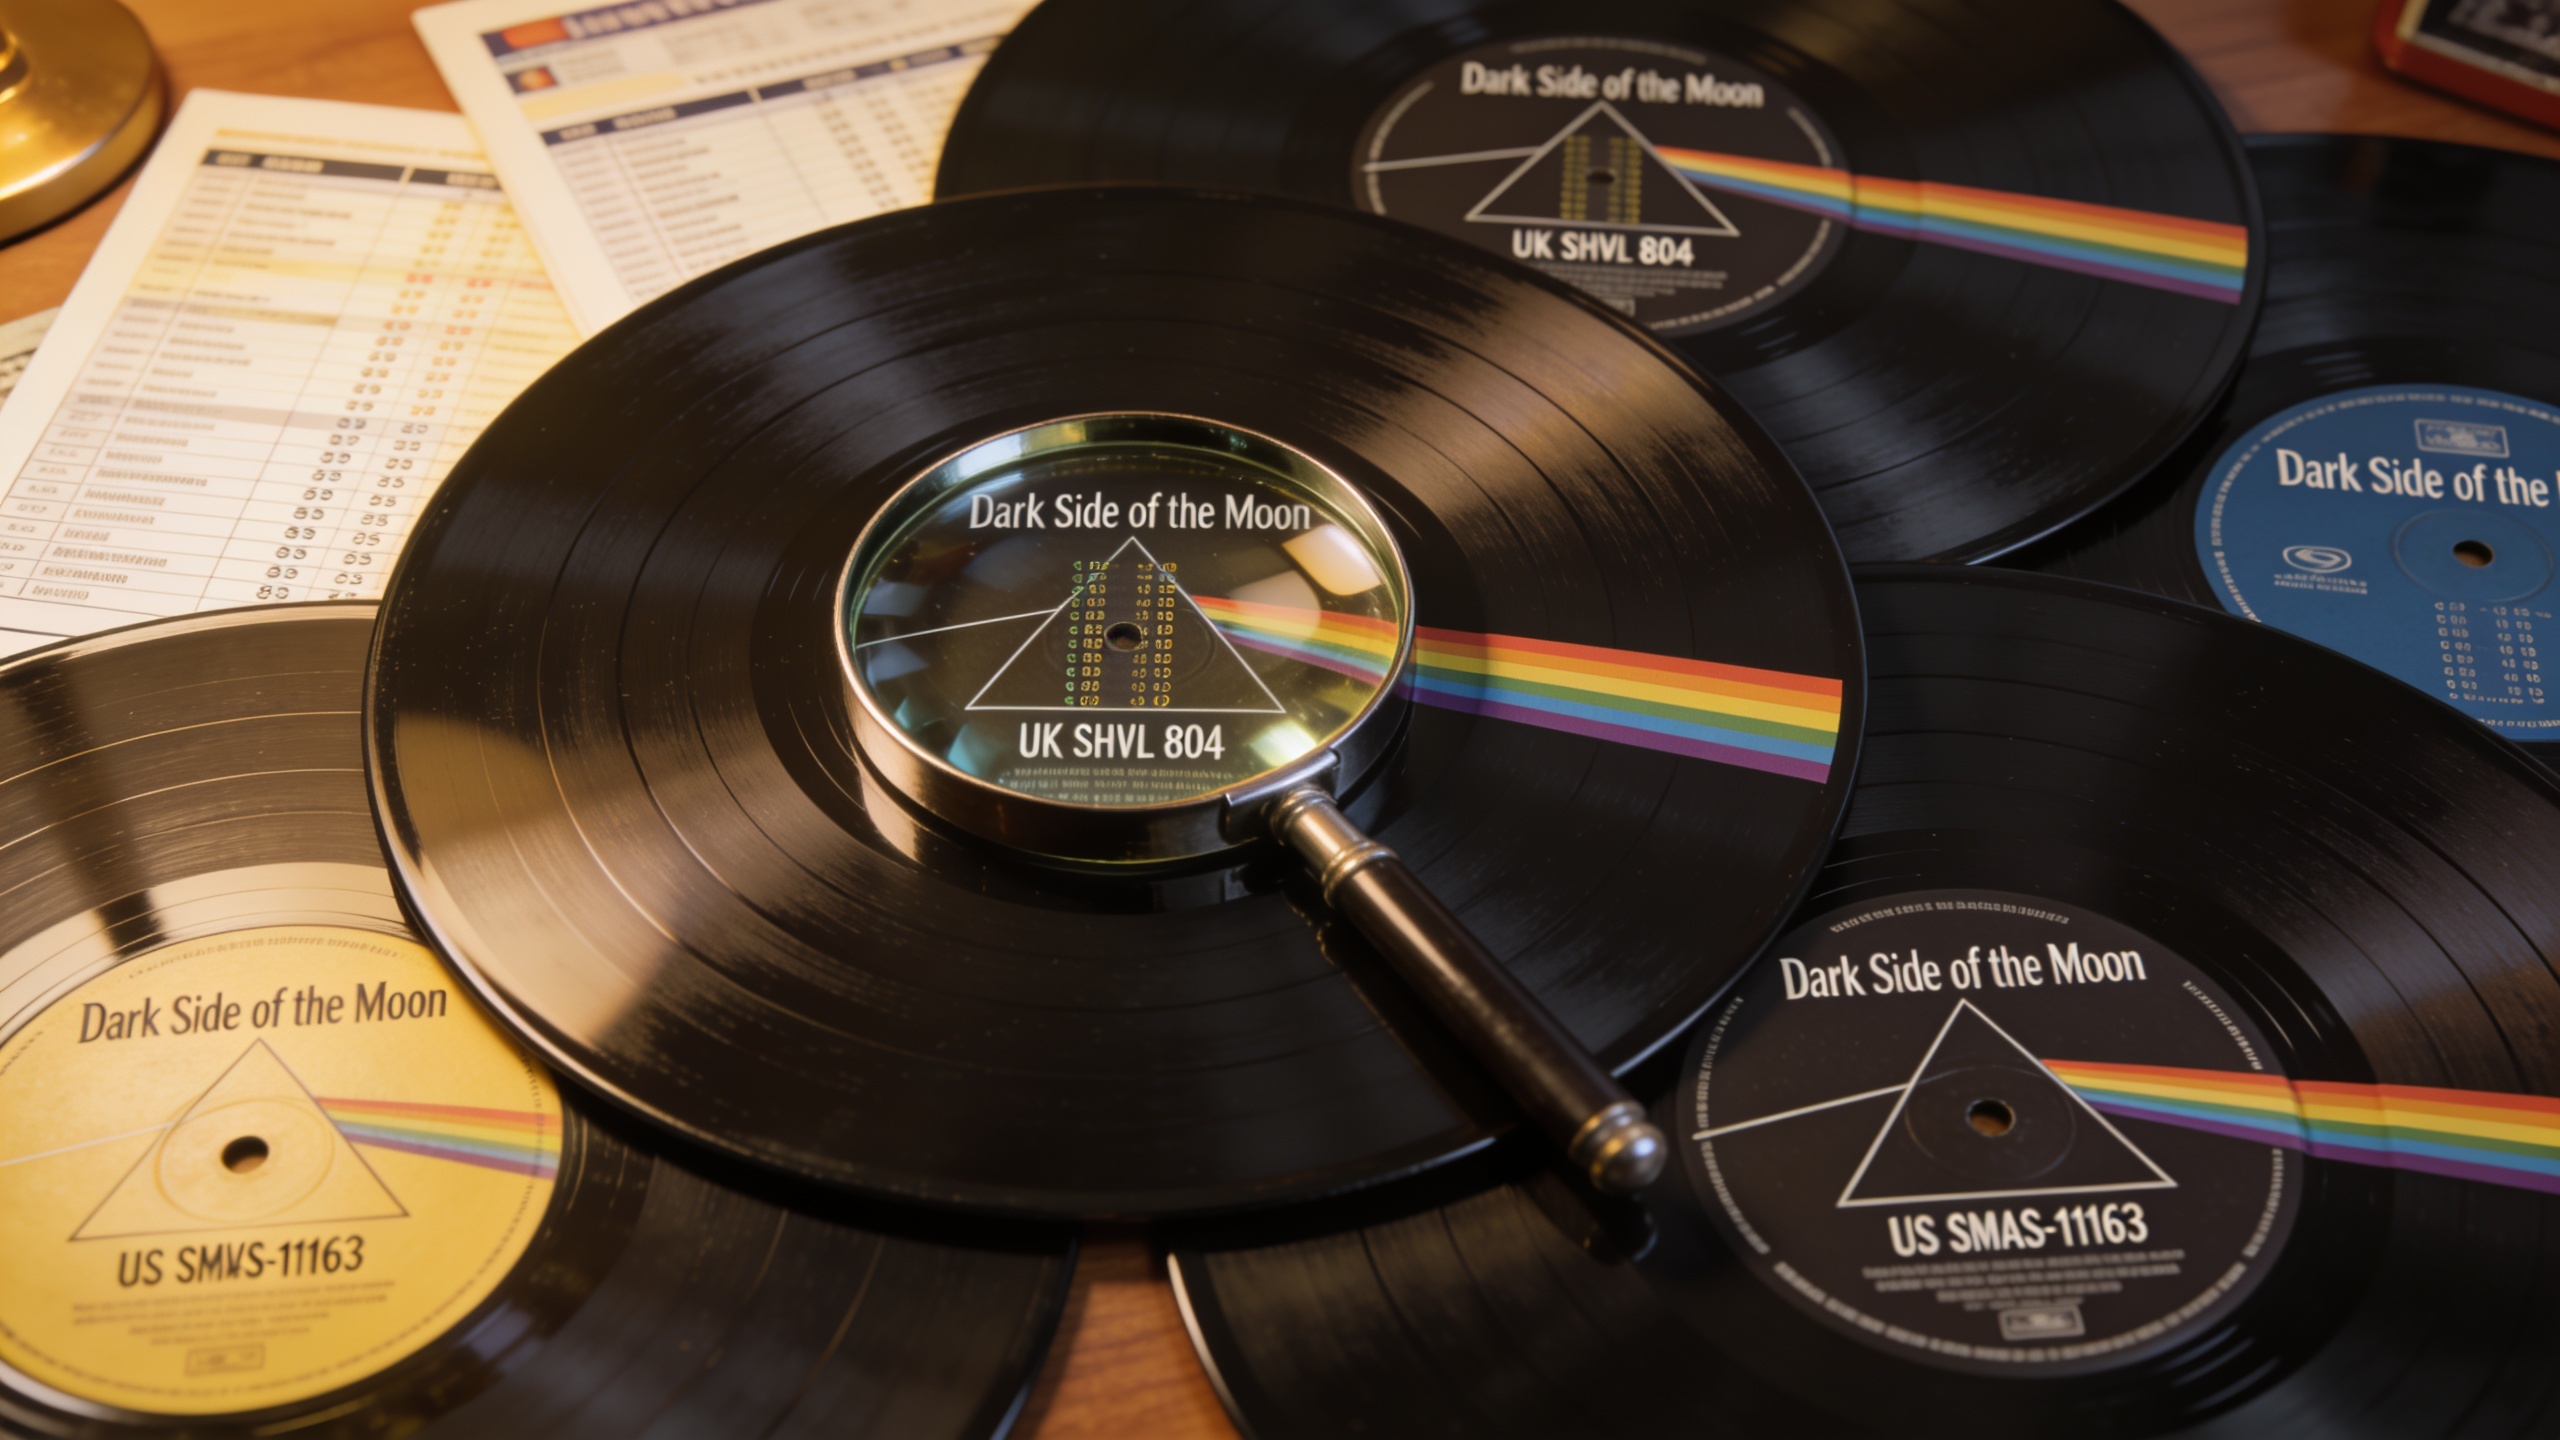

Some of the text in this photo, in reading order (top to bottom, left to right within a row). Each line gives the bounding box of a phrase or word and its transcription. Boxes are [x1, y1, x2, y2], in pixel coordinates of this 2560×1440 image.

[1461, 61, 1765, 108] Dark Side of the Moon
[1512, 228, 1695, 267] UK SHVL 804
[2276, 448, 2363, 492] Dark
[2367, 455, 2444, 499] Side
[2453, 463, 2488, 502] of
[2494, 466, 2550, 507] the
[969, 491, 1312, 530] Dark Side of the Moon
[1019, 722, 1226, 761] UK SHVL 804
[1779, 942, 2148, 1001] Dark Side of the Moon
[78, 981, 447, 1044] Dark Side of the Moon
[1887, 1202, 2150, 1258] US SMAS-11163
[118, 1249, 165, 1288] US
